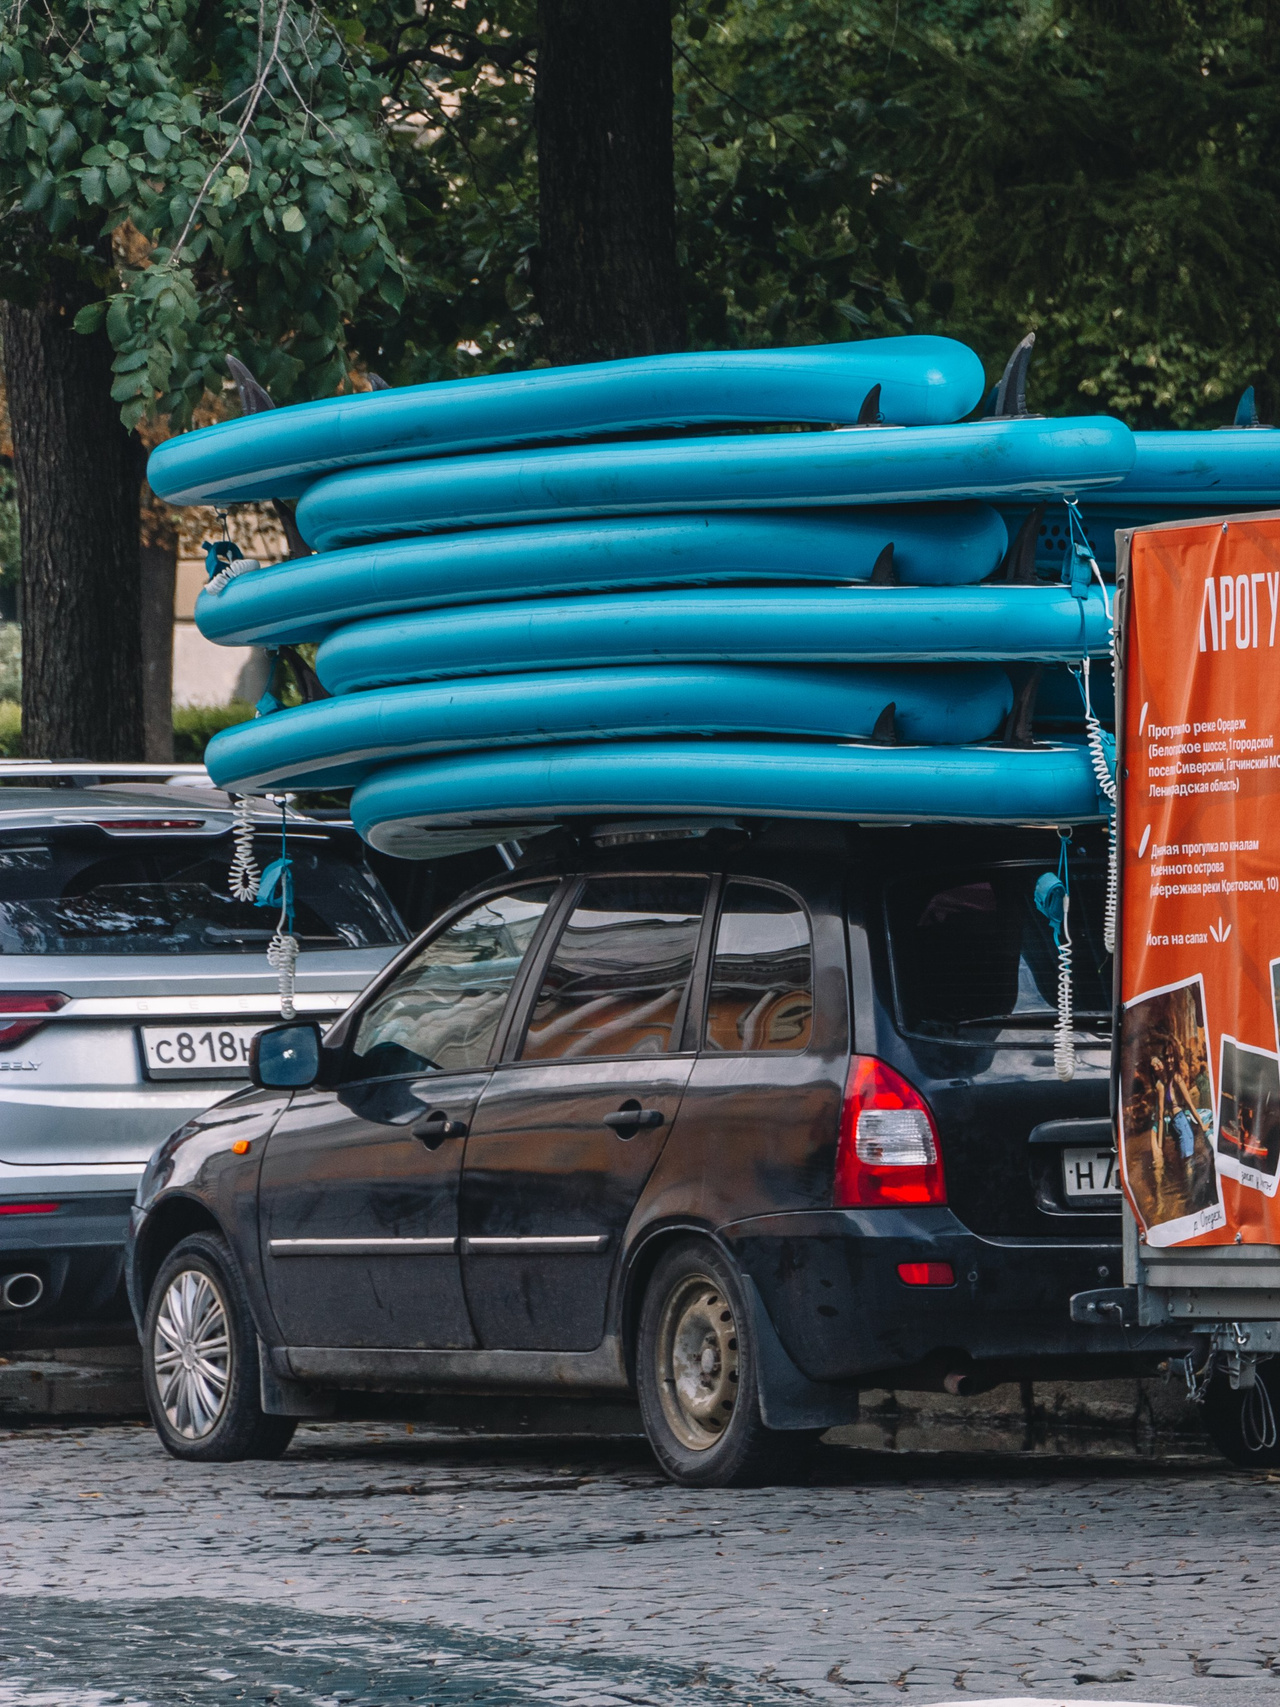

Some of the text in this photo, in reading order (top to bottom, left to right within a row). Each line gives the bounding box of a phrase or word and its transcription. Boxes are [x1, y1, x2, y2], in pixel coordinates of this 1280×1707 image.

[1193, 720, 1216, 736] реке
[1216, 717, 1246, 734] Оредеж
[1203, 741, 1228, 754] шоссе,
[1175, 758, 1226, 776] Сиверский,
[1226, 756, 1269, 771] Гатчинский
[1210, 777, 1240, 793] область)
[1181, 842, 1219, 857] прогулка
[1219, 841, 1229, 852] по
[1193, 862, 1224, 876] острова
[1202, 881, 1221, 896] реки
[1266, 876, 1279, 892] 10)
[1146, 930, 1208, 946] Йога на сапах
[1075, 1152, 1121, 1190] Н7
